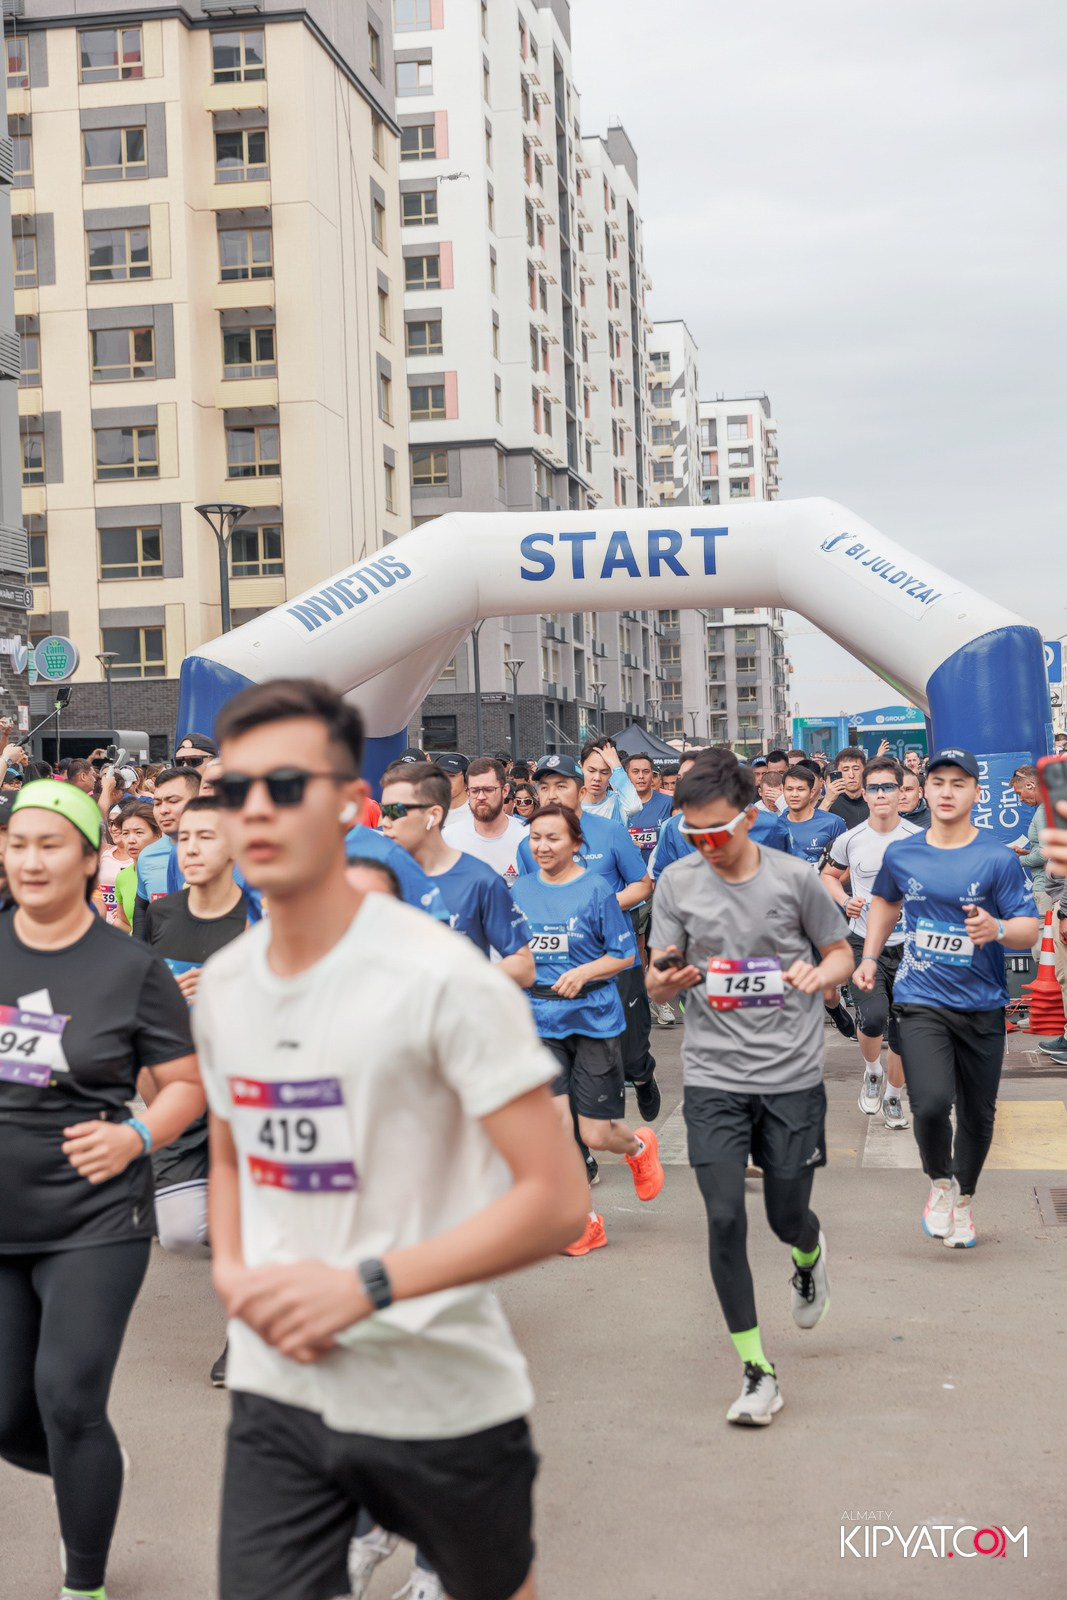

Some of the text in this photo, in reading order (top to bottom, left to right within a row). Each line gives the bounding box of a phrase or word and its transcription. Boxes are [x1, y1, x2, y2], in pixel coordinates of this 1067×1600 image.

[520, 527, 729, 581] START
[845, 543, 942, 605] BI JULDYZAI
[286, 555, 411, 632] INVICTUS
[926, 934, 963, 952] 1119
[725, 976, 766, 993] 145
[259, 1117, 318, 1154] 419
